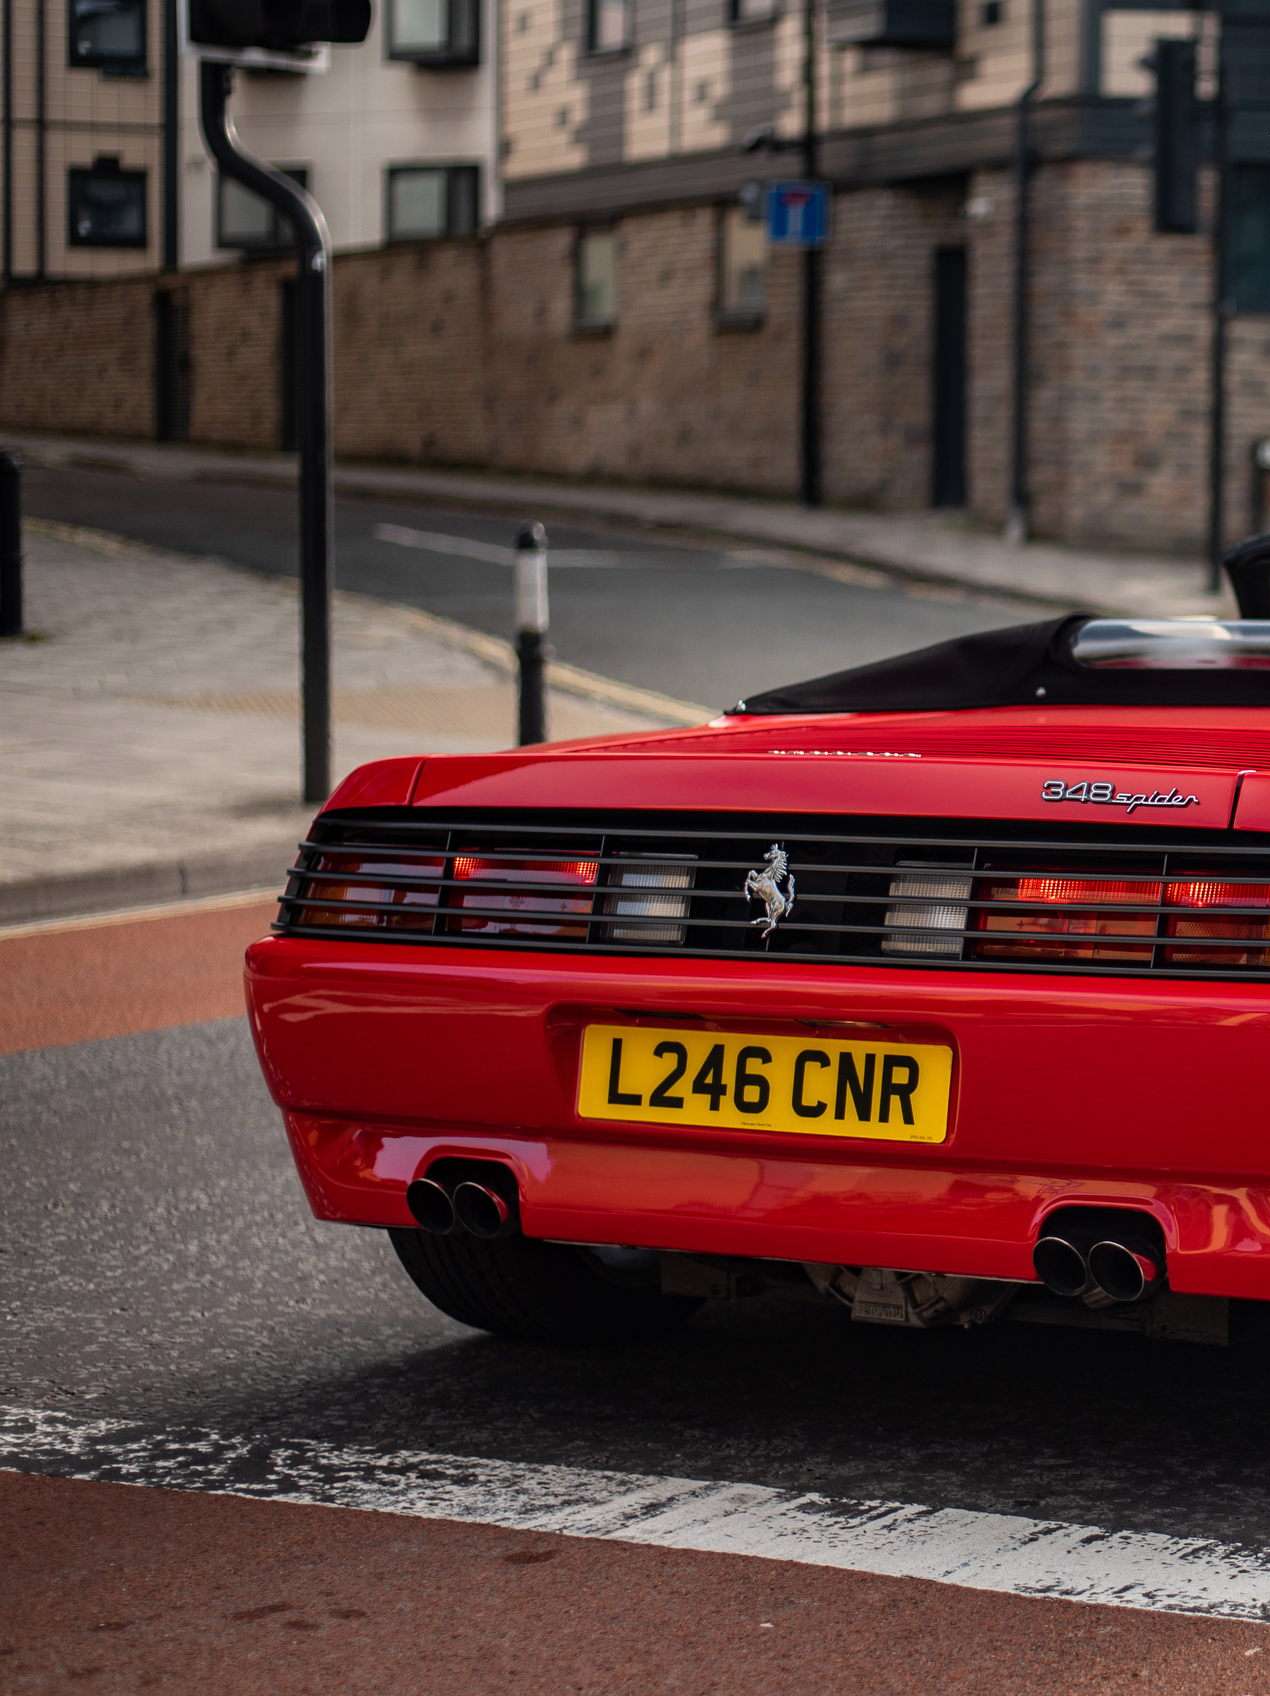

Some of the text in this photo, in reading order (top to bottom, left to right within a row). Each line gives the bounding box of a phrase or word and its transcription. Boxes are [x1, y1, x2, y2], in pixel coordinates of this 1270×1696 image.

[1041, 780, 1199, 814] 348 spider
[607, 1037, 920, 1126] L246 CNR
